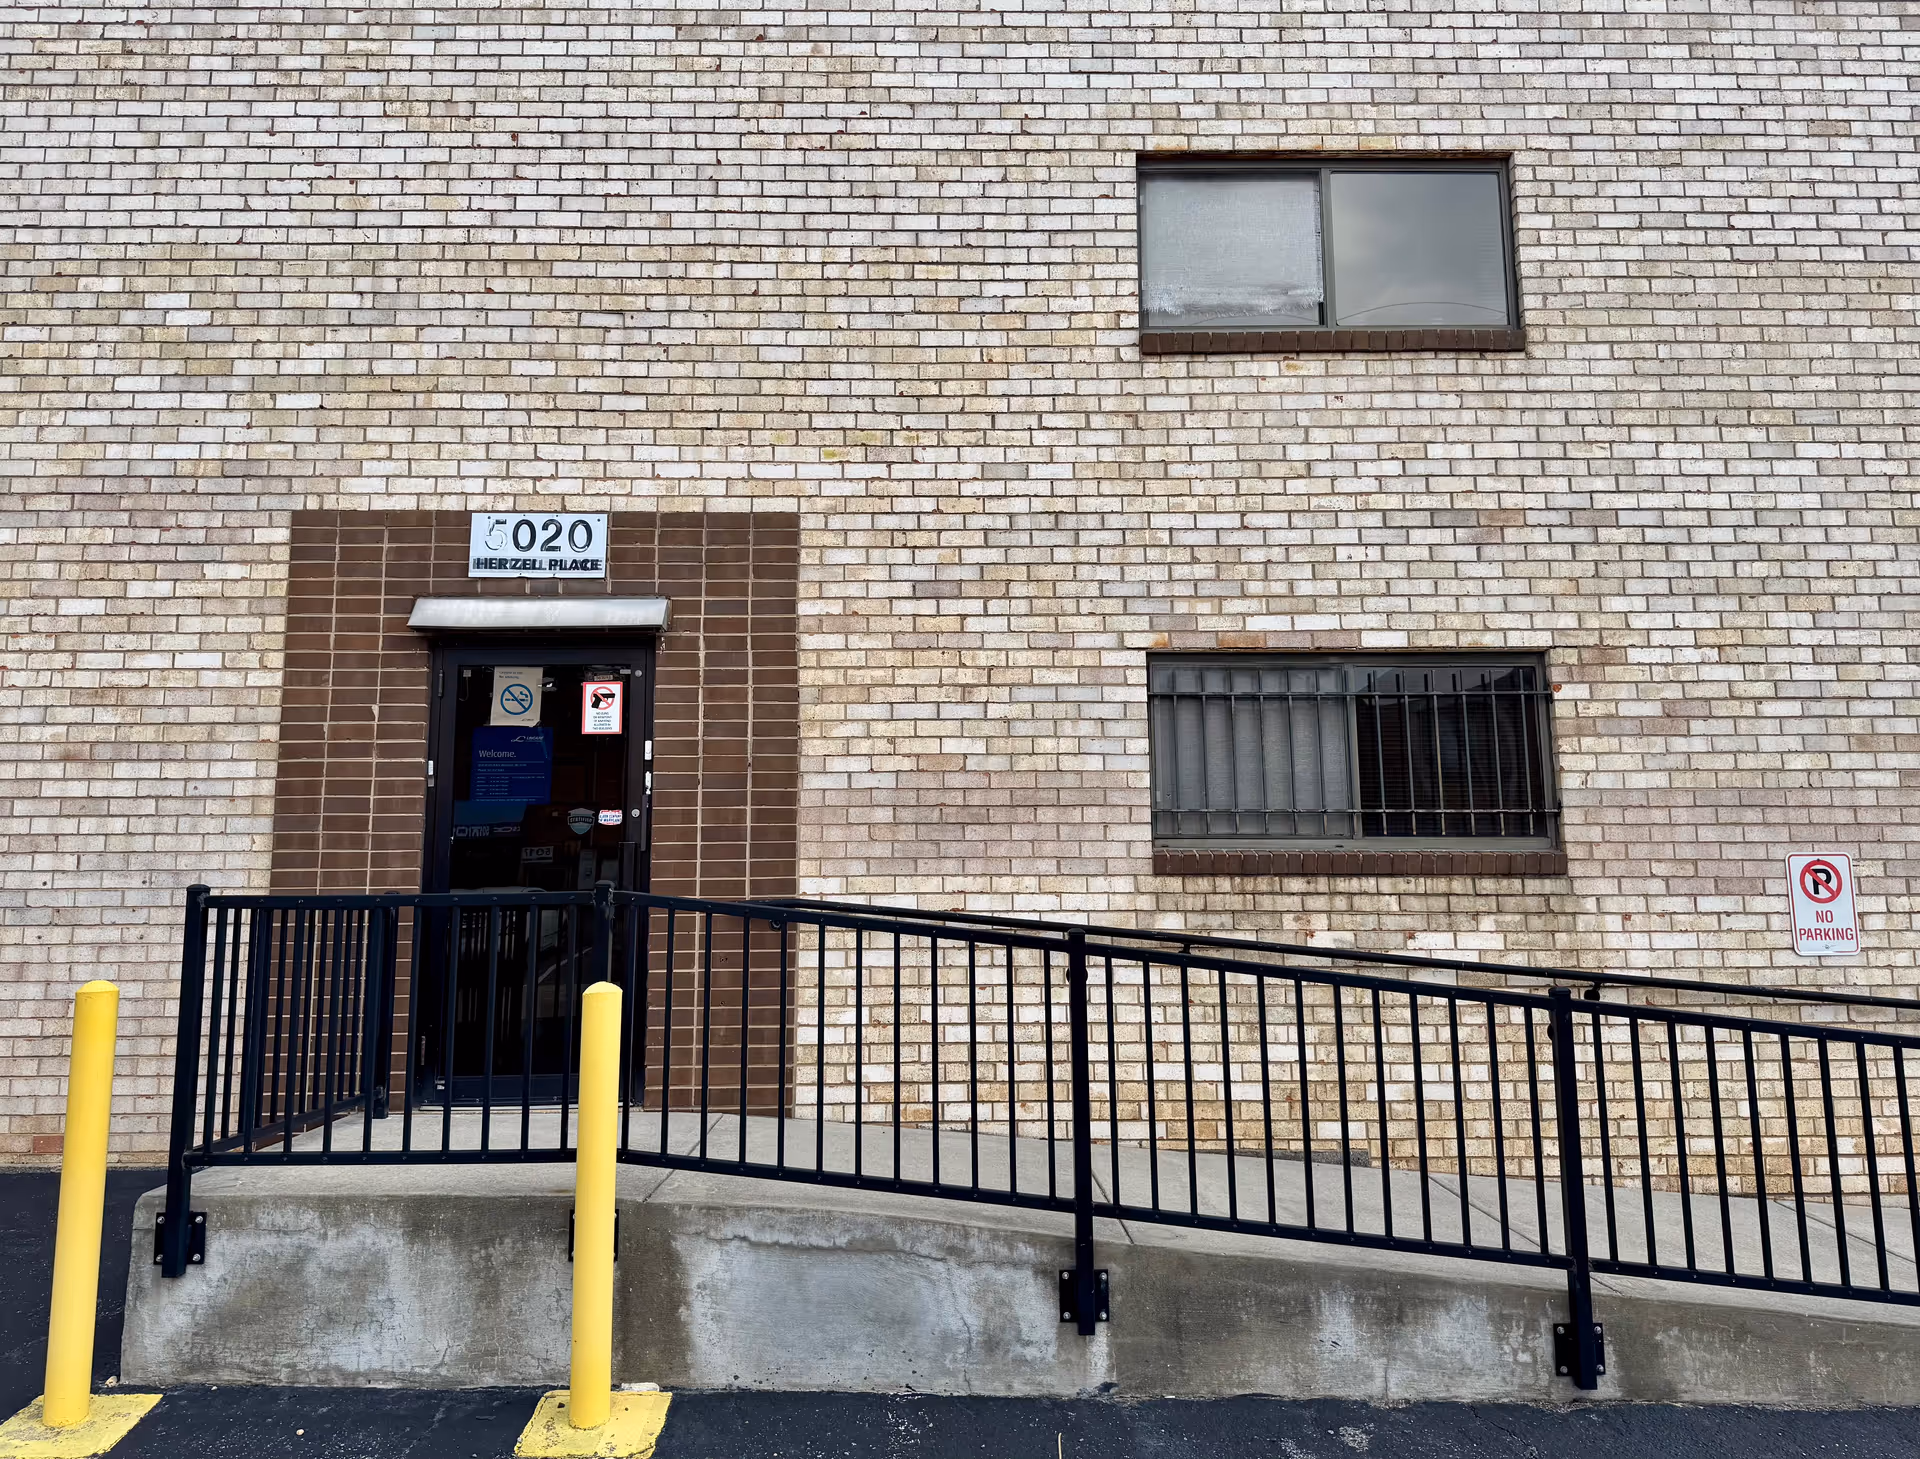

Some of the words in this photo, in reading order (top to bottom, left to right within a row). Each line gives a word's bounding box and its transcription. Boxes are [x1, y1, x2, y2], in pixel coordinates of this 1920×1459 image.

[484, 518, 593, 553] 5020
[473, 557, 546, 571] HERZEL
[548, 558, 602, 572] PLACE
[1815, 910, 1834, 923] NO
[1799, 927, 1854, 941] PARKING
